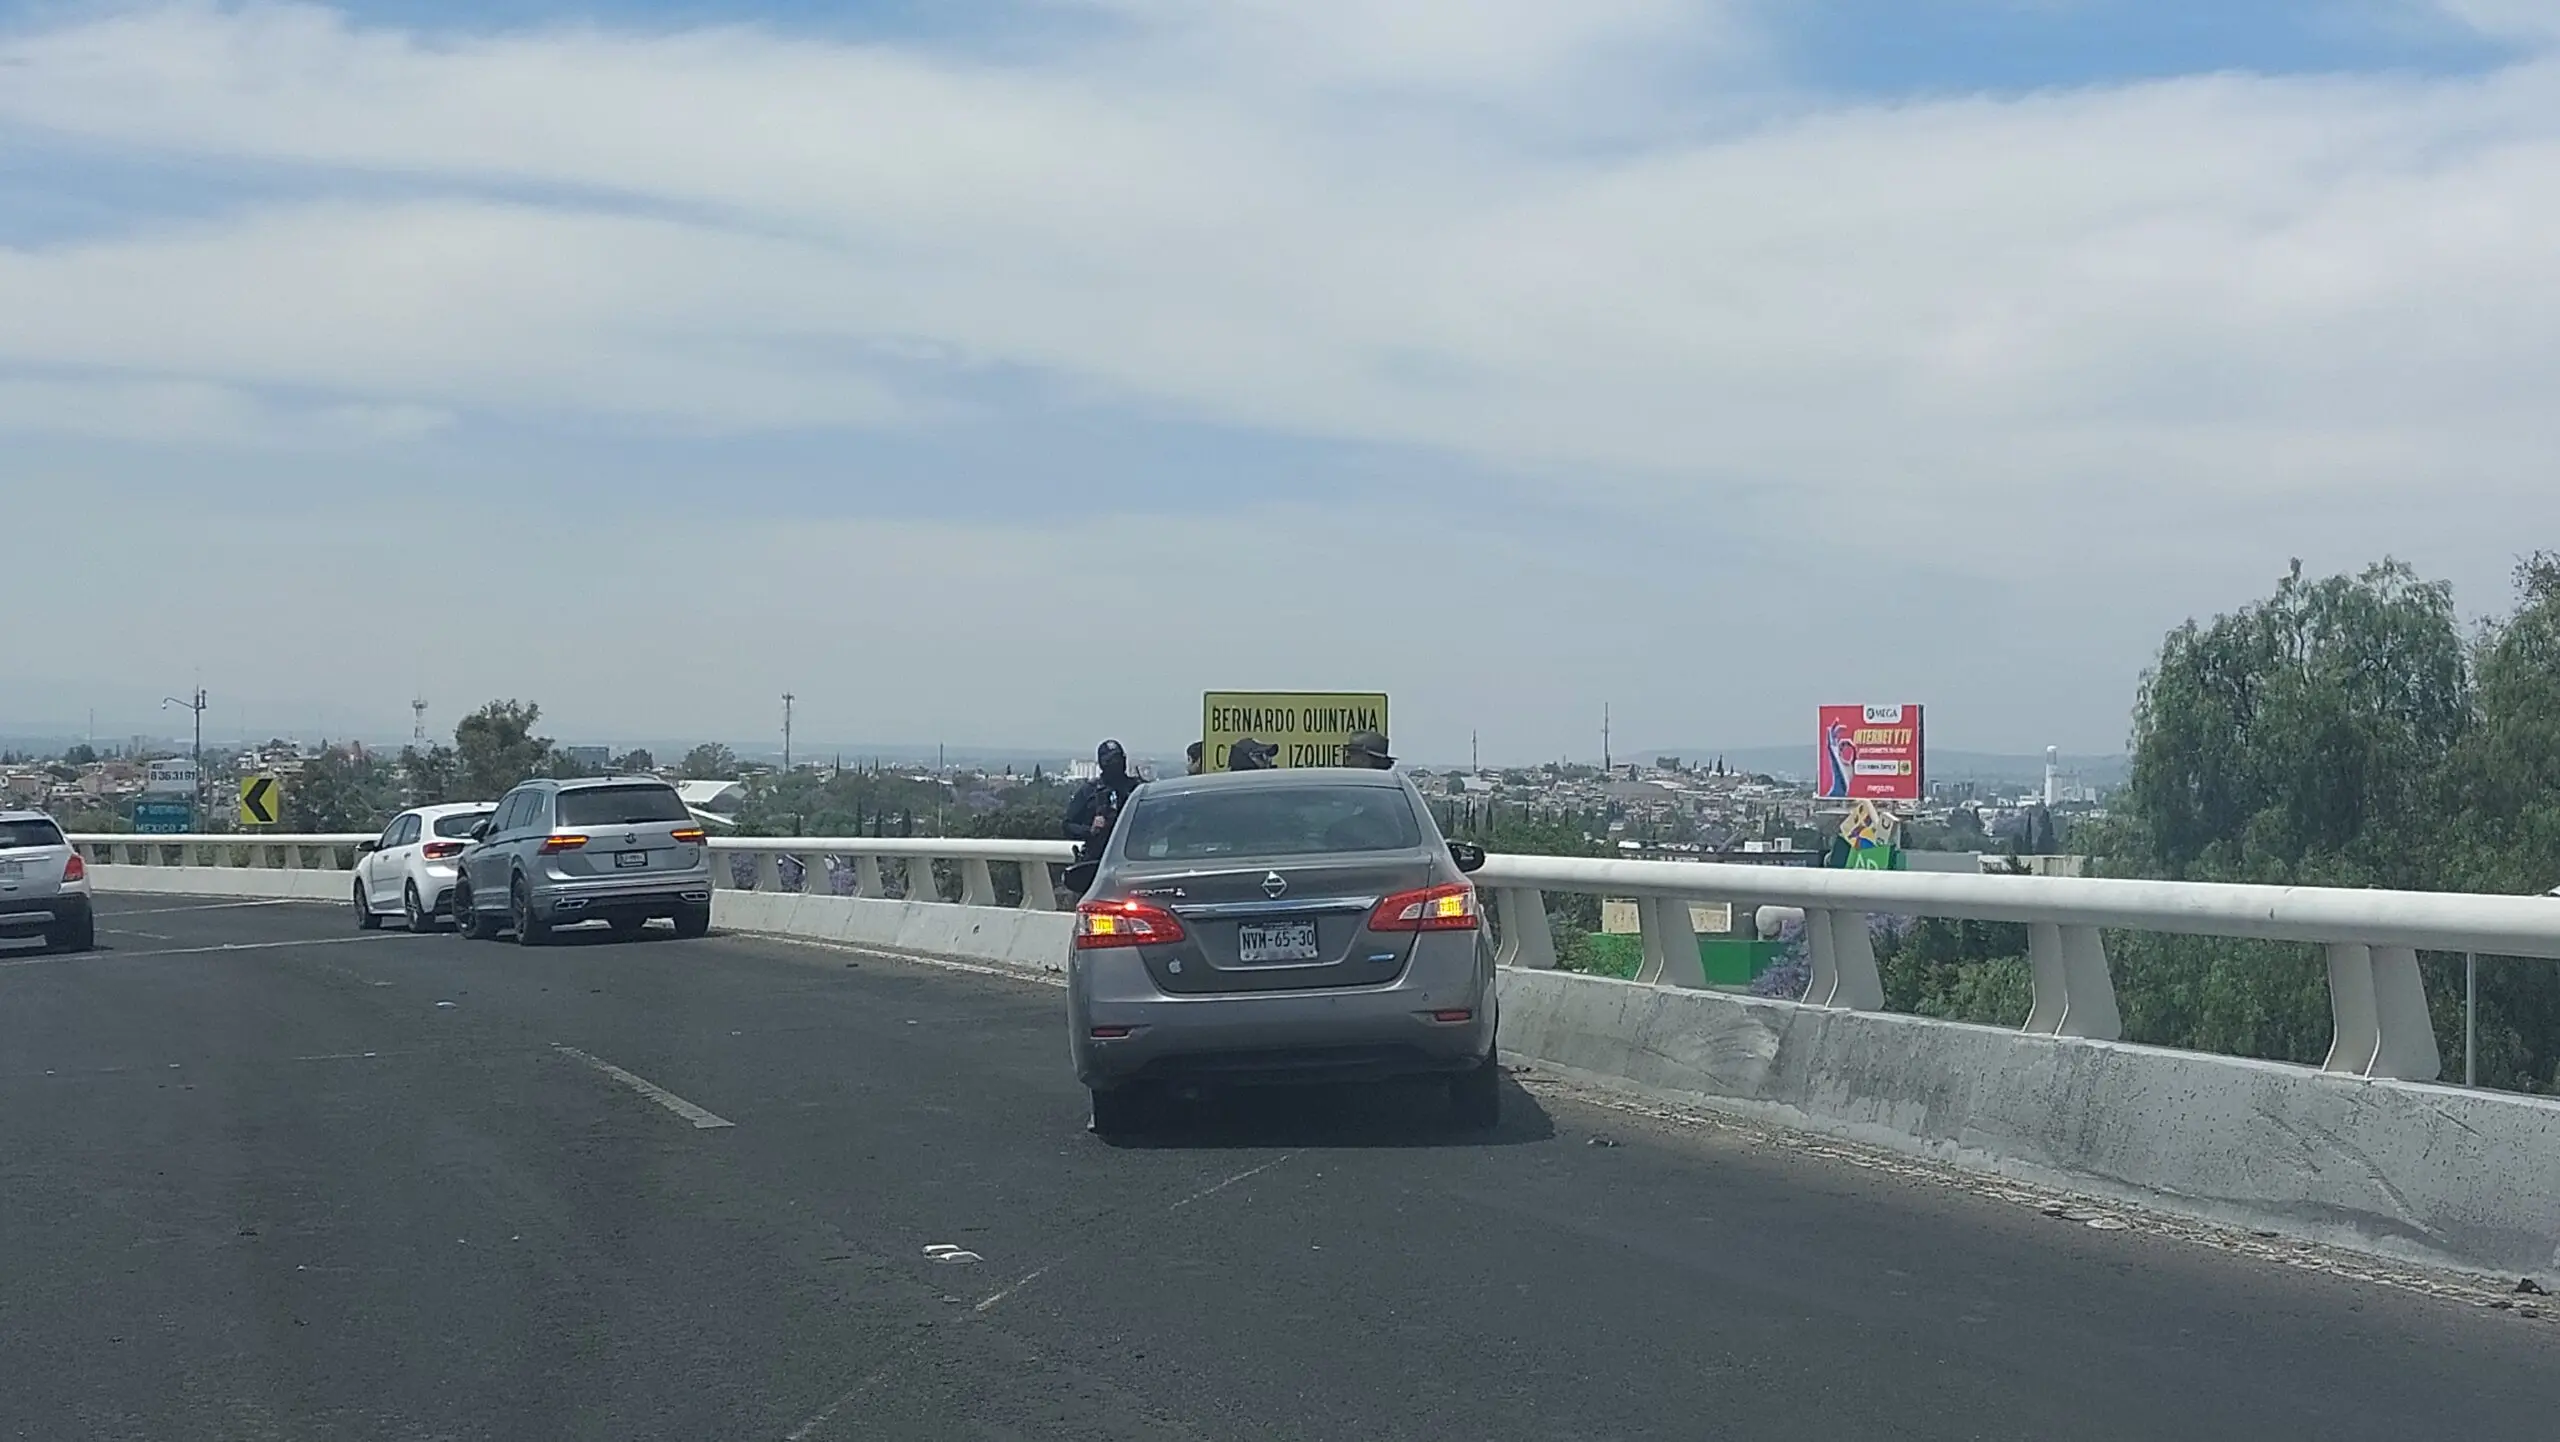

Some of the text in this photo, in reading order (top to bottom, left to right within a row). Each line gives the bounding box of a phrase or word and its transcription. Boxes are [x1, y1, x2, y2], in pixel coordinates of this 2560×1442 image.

[1212, 706, 1379, 733] BERNARDO QUINTANA
[1853, 728, 1893, 745] INTERNET
[1289, 743, 1347, 768] IZQUIE
